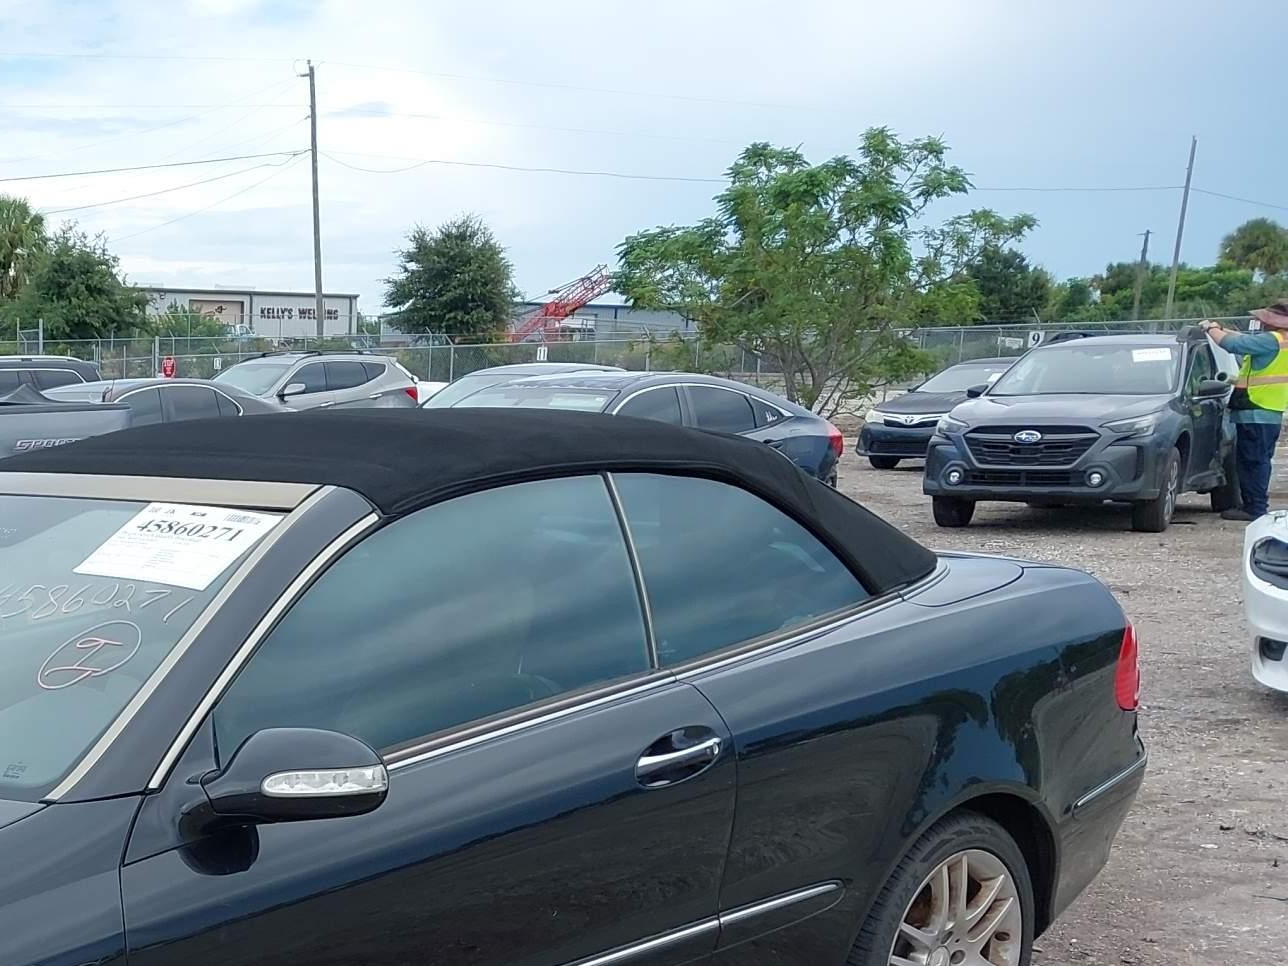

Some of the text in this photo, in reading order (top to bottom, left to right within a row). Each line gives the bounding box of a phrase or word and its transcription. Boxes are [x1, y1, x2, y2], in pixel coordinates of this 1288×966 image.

[260, 307, 339, 320] KELLY'S WELING
[1032, 333, 1040, 347] 9
[137, 519, 244, 542] 45860271
